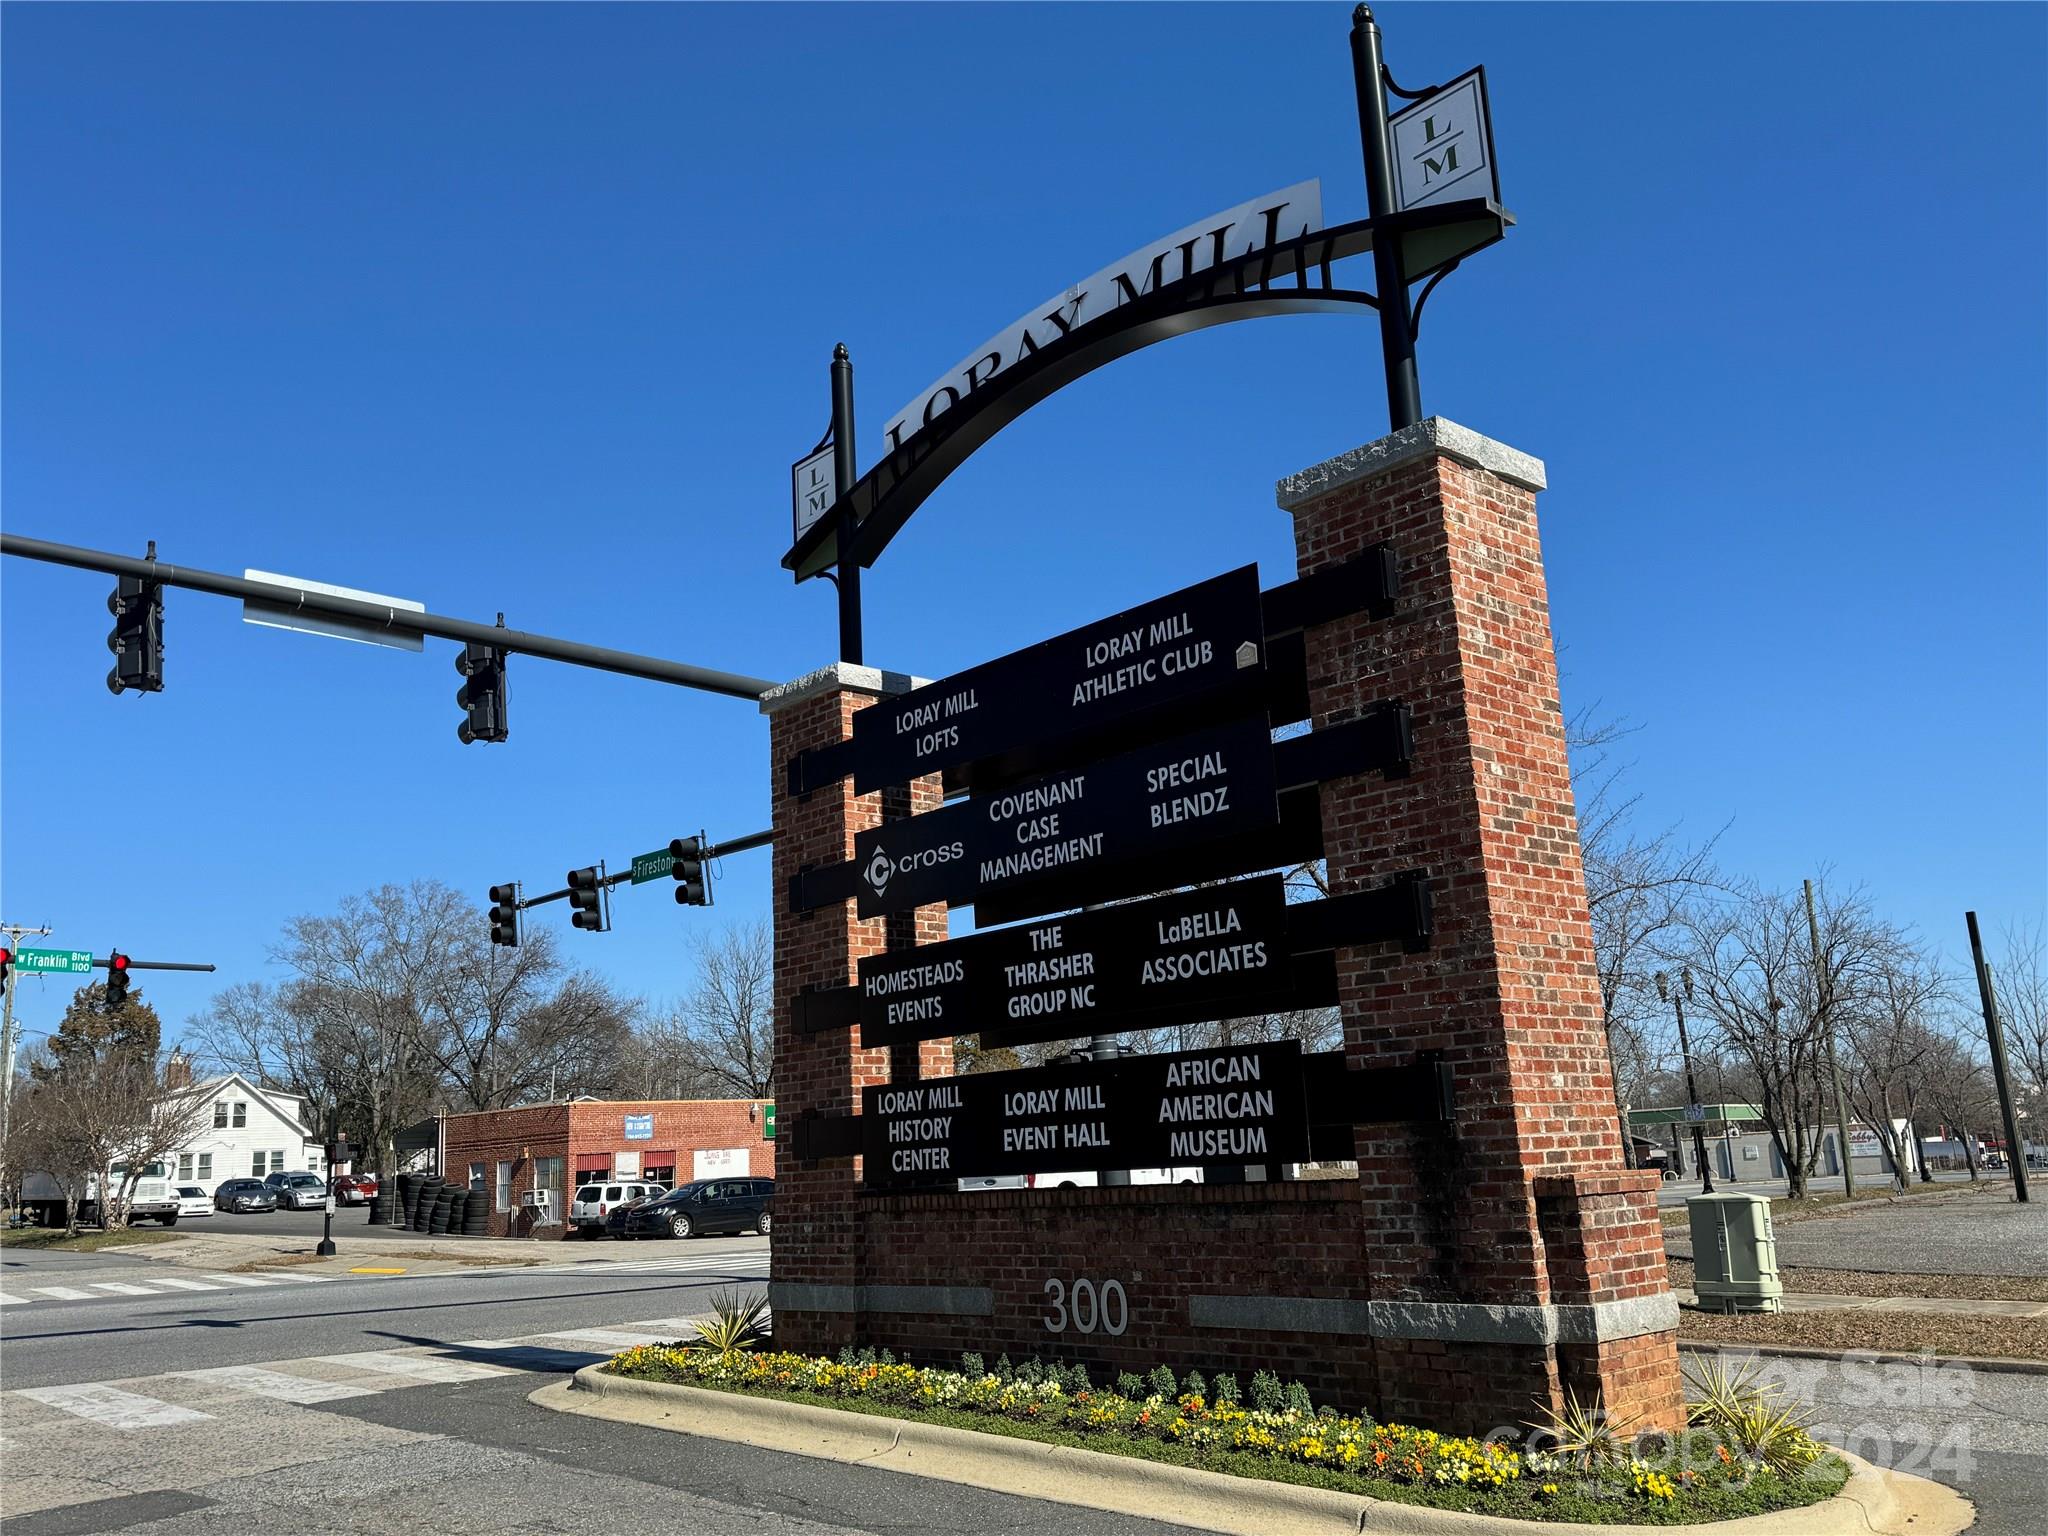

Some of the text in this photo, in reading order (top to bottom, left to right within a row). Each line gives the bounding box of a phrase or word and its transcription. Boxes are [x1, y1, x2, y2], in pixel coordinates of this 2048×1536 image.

[1421, 113, 1452, 145] L
[1420, 142, 1461, 187] M
[885, 201, 1309, 450] LORAY MILL
[810, 467, 825, 488] L
[808, 490, 827, 517] M
[1086, 612, 1193, 669] LORAY MILL
[1072, 640, 1213, 707] ATHLETIC CLUB
[896, 688, 979, 735] LORAY MILL
[916, 725, 959, 757] LOFTS
[1146, 751, 1227, 793] SPECIAL
[989, 775, 1085, 822] COVENANT
[1150, 786, 1230, 828] BLENDZ
[1016, 813, 1060, 844] CASE
[899, 841, 964, 873] cross
[980, 832, 1104, 884] MANAGEMENT
[1029, 925, 1063, 952] THE
[1158, 907, 1242, 945] LaBELLA
[27, 952, 68, 969] Franklin
[71, 951, 91, 962] Blvd
[71, 962, 90, 972] 1100
[1004, 952, 1095, 988] THRASHER
[1141, 941, 1267, 985] ASSOCIATES
[865, 959, 964, 997] HOMESTEADS
[888, 995, 943, 1025] EVENTS
[1007, 984, 1096, 1018] GROUP NC
[1166, 1054, 1260, 1088] AFRICAN
[878, 1085, 963, 1115] LORAY MILL
[1004, 1085, 1106, 1116] LORAY MILL
[1158, 1089, 1274, 1123] AMERICAN
[888, 1116, 952, 1143] HISTORY
[1003, 1121, 1111, 1152] EVENT HALL
[1170, 1126, 1268, 1157] MUSEUM
[892, 1147, 950, 1173] CENTER
[1043, 1277, 1128, 1336] 300
